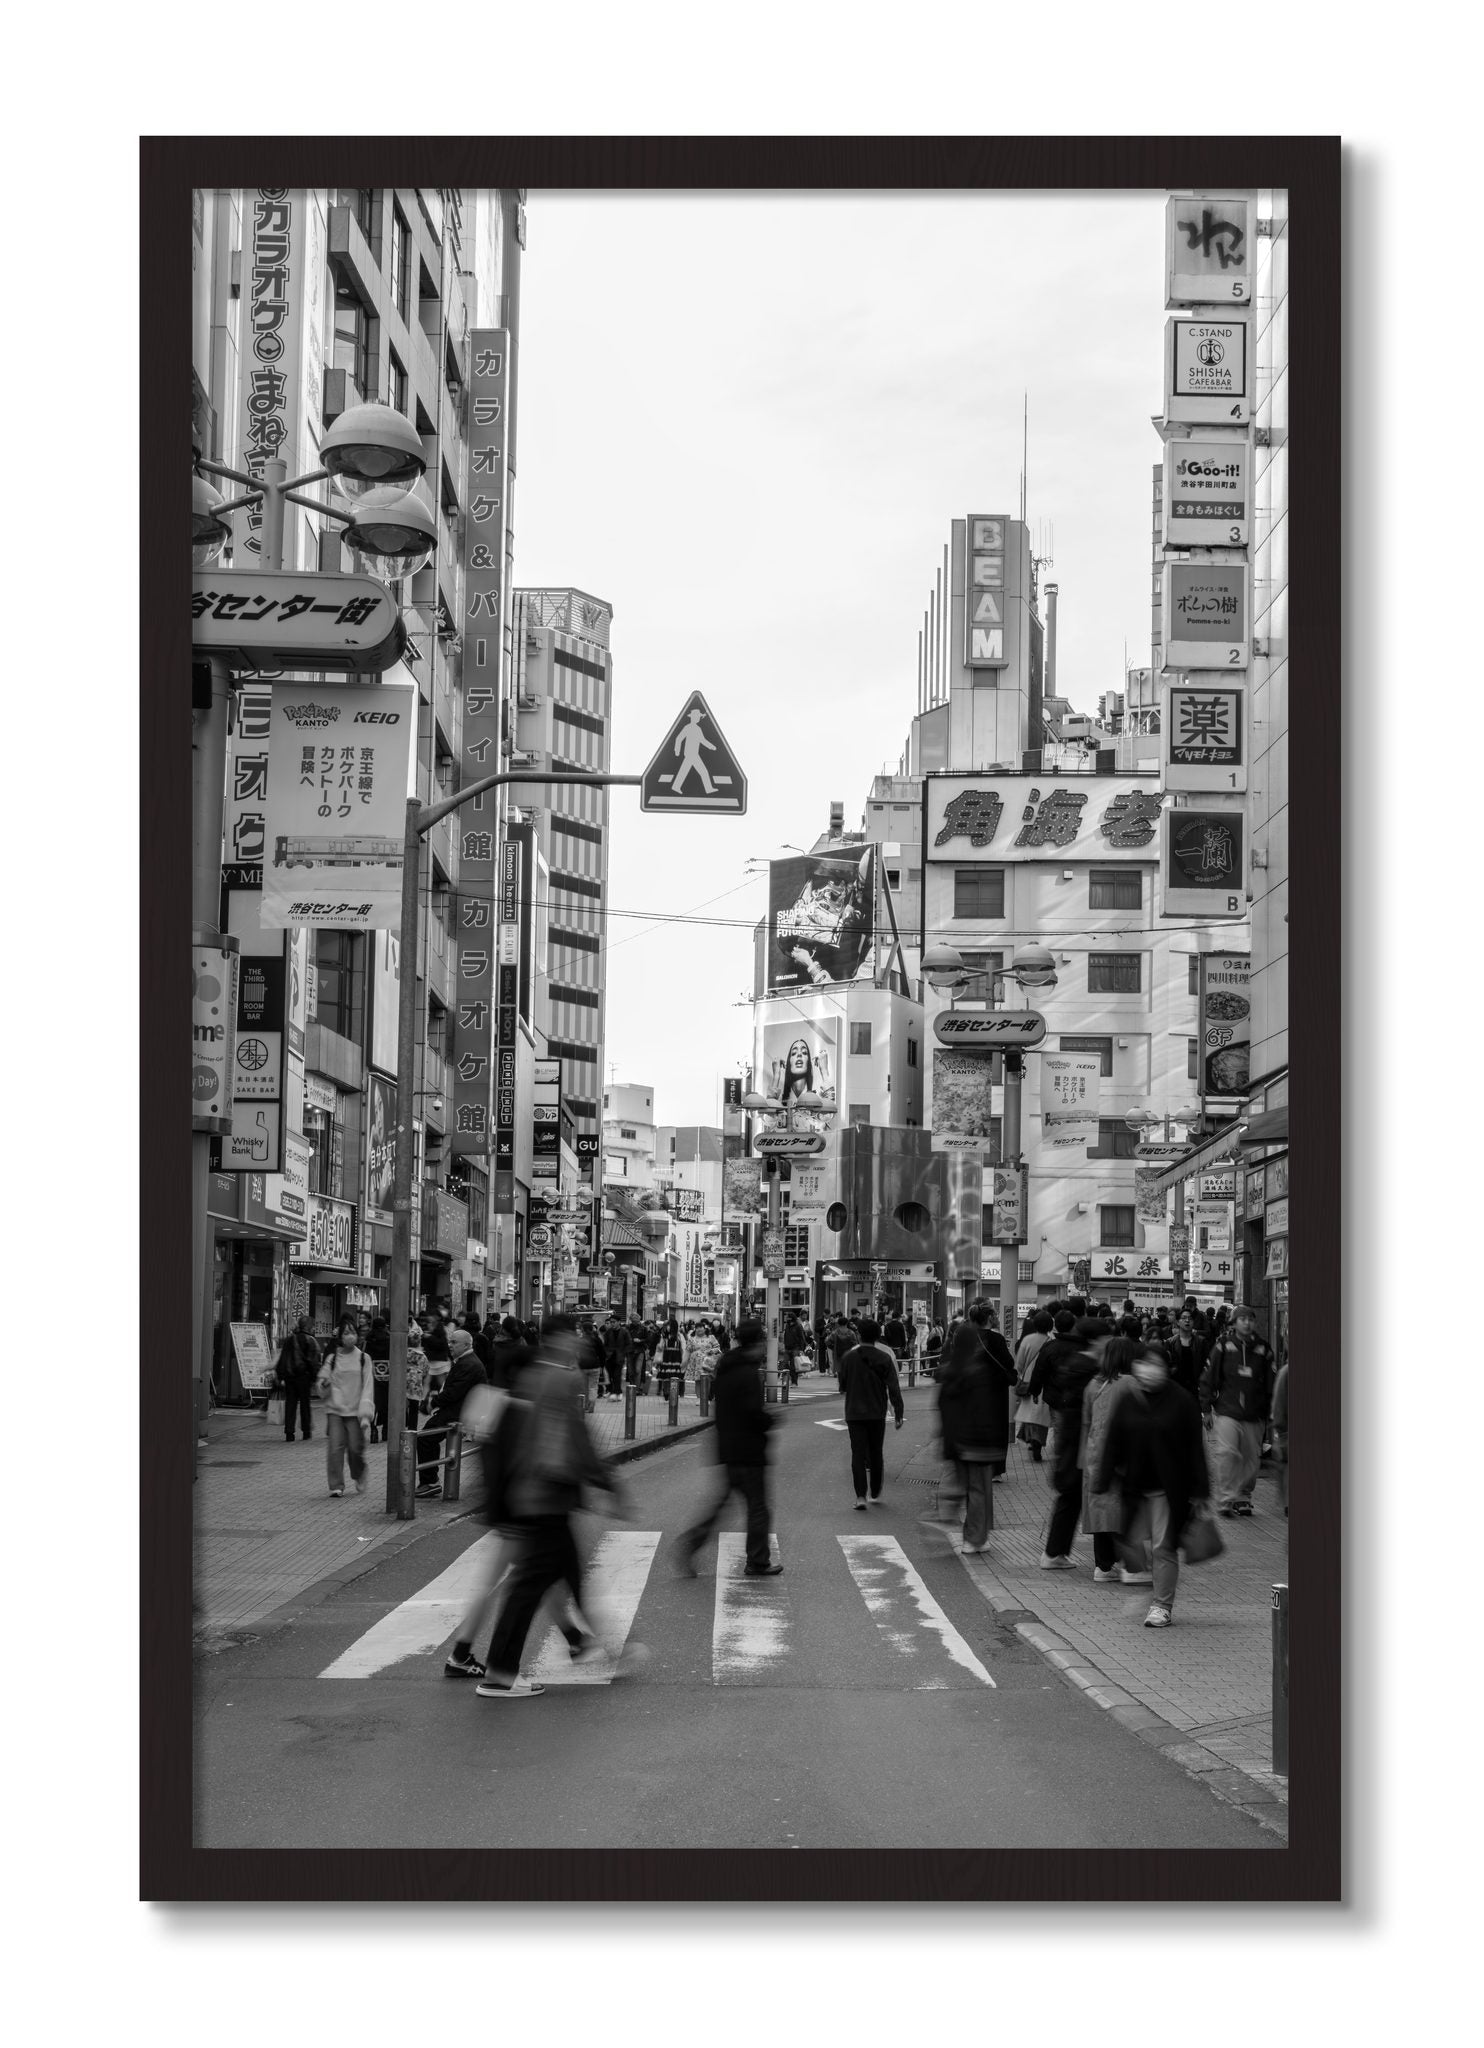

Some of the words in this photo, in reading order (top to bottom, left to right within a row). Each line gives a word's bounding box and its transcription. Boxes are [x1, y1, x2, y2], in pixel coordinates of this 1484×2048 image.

[250, 200, 292, 333] カラオケ
[1231, 282, 1244, 298] 5
[1189, 328, 1233, 337] C.STAND
[1189, 367, 1232, 377] SHISHA
[1189, 378, 1232, 386] CAFE&BAR
[1187, 461, 1240, 477] Goo-it!
[1181, 480, 1237, 489] 渋谷宇田川町店
[1176, 504, 1241, 516] 全身もみほぐし
[1229, 526, 1241, 543] 3
[972, 519, 1004, 660] BEAM
[1177, 594, 1239, 614] ポムの樹
[1229, 649, 1240, 664] 2
[353, 712, 400, 724] KEIO
[1180, 696, 1228, 745] 薬
[300, 746, 316, 787] 冒険へ
[317, 746, 335, 817] カントーの
[358, 747, 374, 804] 京王線で
[1228, 772, 1236, 787] 1
[934, 788, 1164, 847] 角海老
[1174, 826, 1232, 872] 一蘭
[506, 846, 515, 881] kimono
[506, 885, 514, 918] hearts
[1227, 896, 1239, 912] B
[1207, 973, 1250, 985] 四川料理
[456, 900, 490, 1134] カラオケ館
[940, 1019, 1039, 1032] 渋谷センター街
[1205, 1028, 1234, 1047] 6F
[198, 1075, 217, 1088] Day!
[231, 1146, 251, 1154] Bank
[232, 1137, 264, 1148] Whisky
[578, 1140, 598, 1151] GU
[1104, 1255, 1161, 1276] 兆楽
[693, 1253, 701, 1295] BEER
